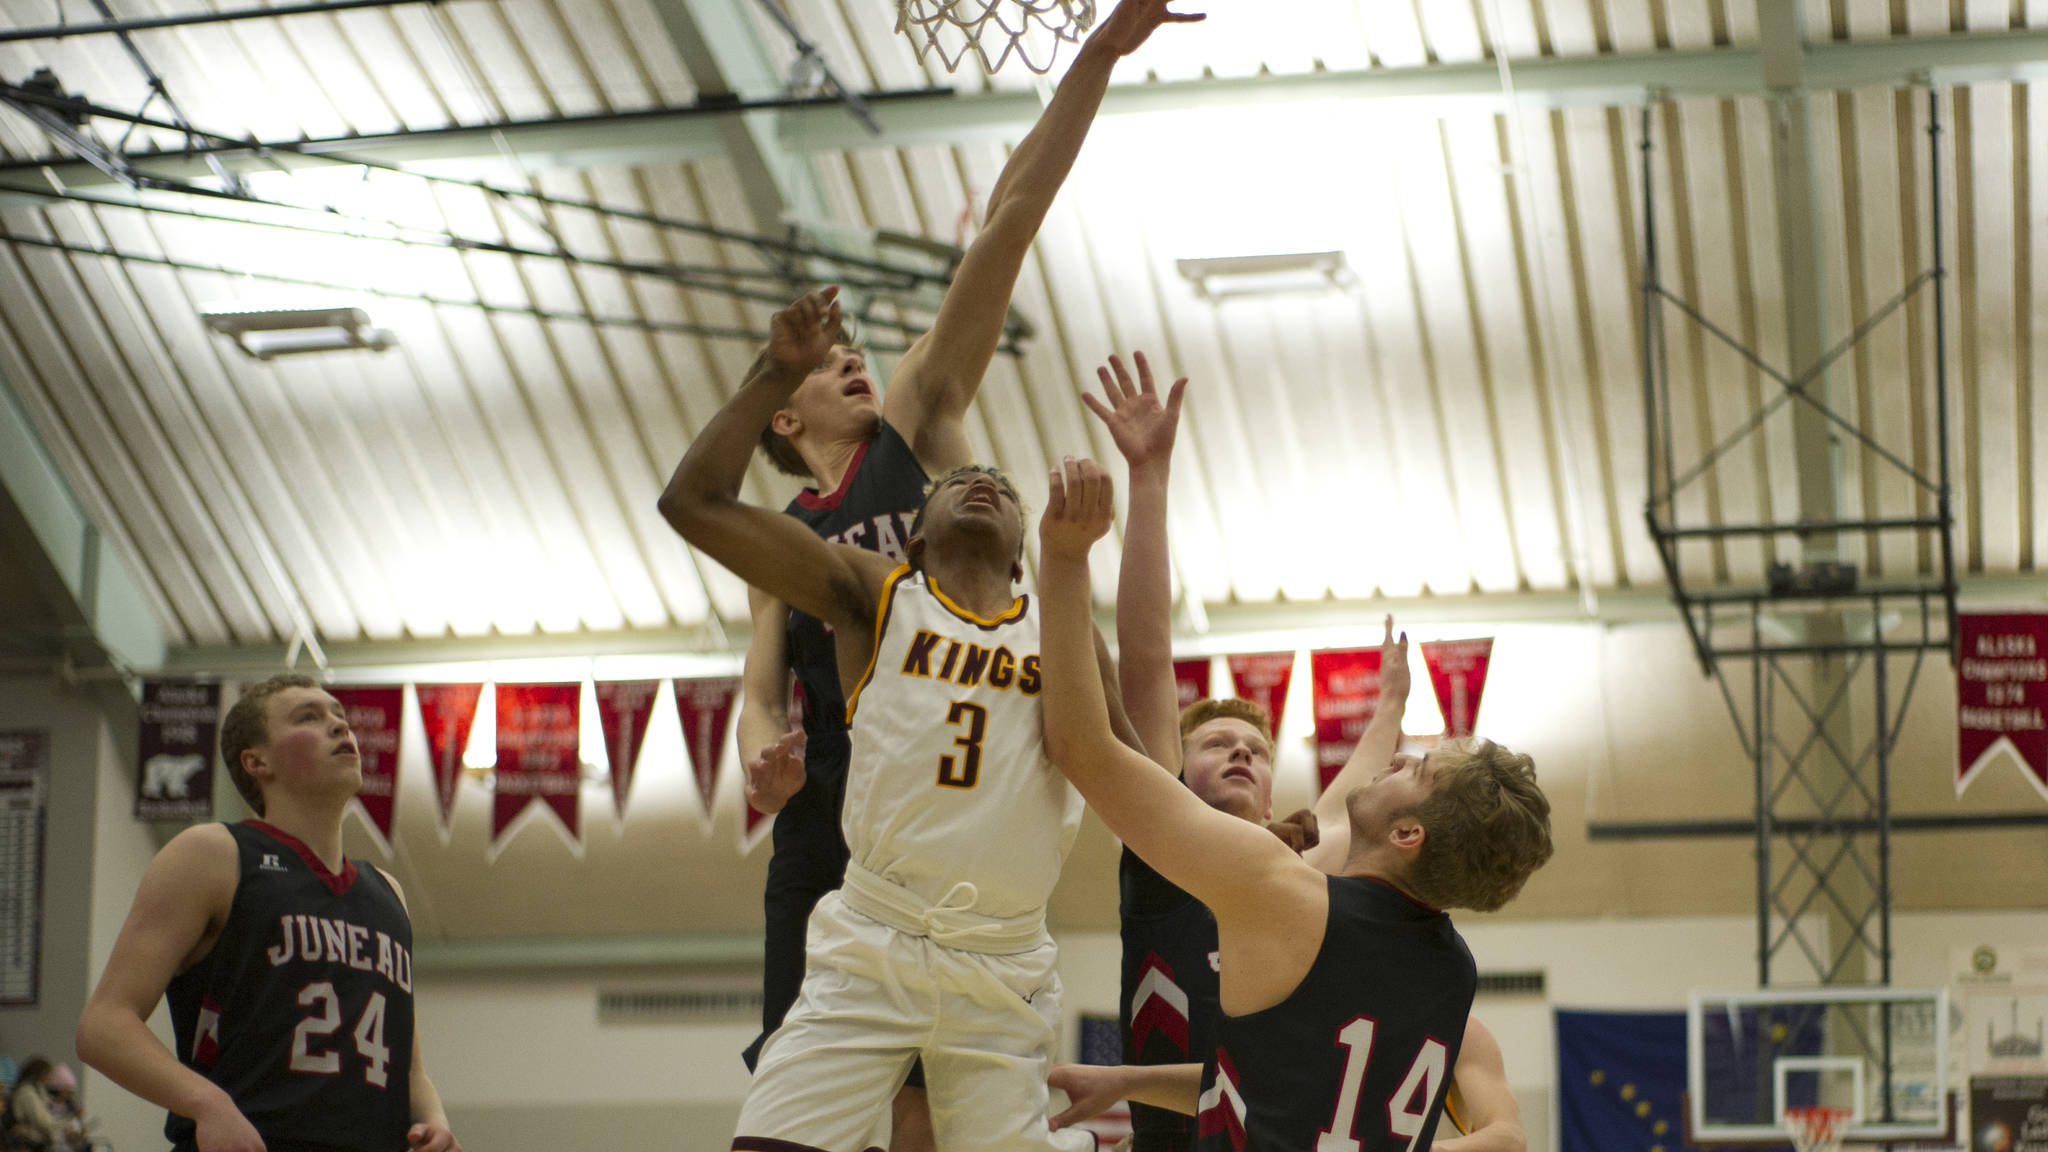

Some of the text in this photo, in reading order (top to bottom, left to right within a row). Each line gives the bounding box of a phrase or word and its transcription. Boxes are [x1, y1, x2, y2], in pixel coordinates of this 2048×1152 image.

[901, 629, 1041, 697] KINGS
[936, 700, 988, 790] 3
[266, 914, 413, 995] JUNEAU
[288, 980, 391, 1090] 24
[1312, 1013, 1449, 1152] 14
